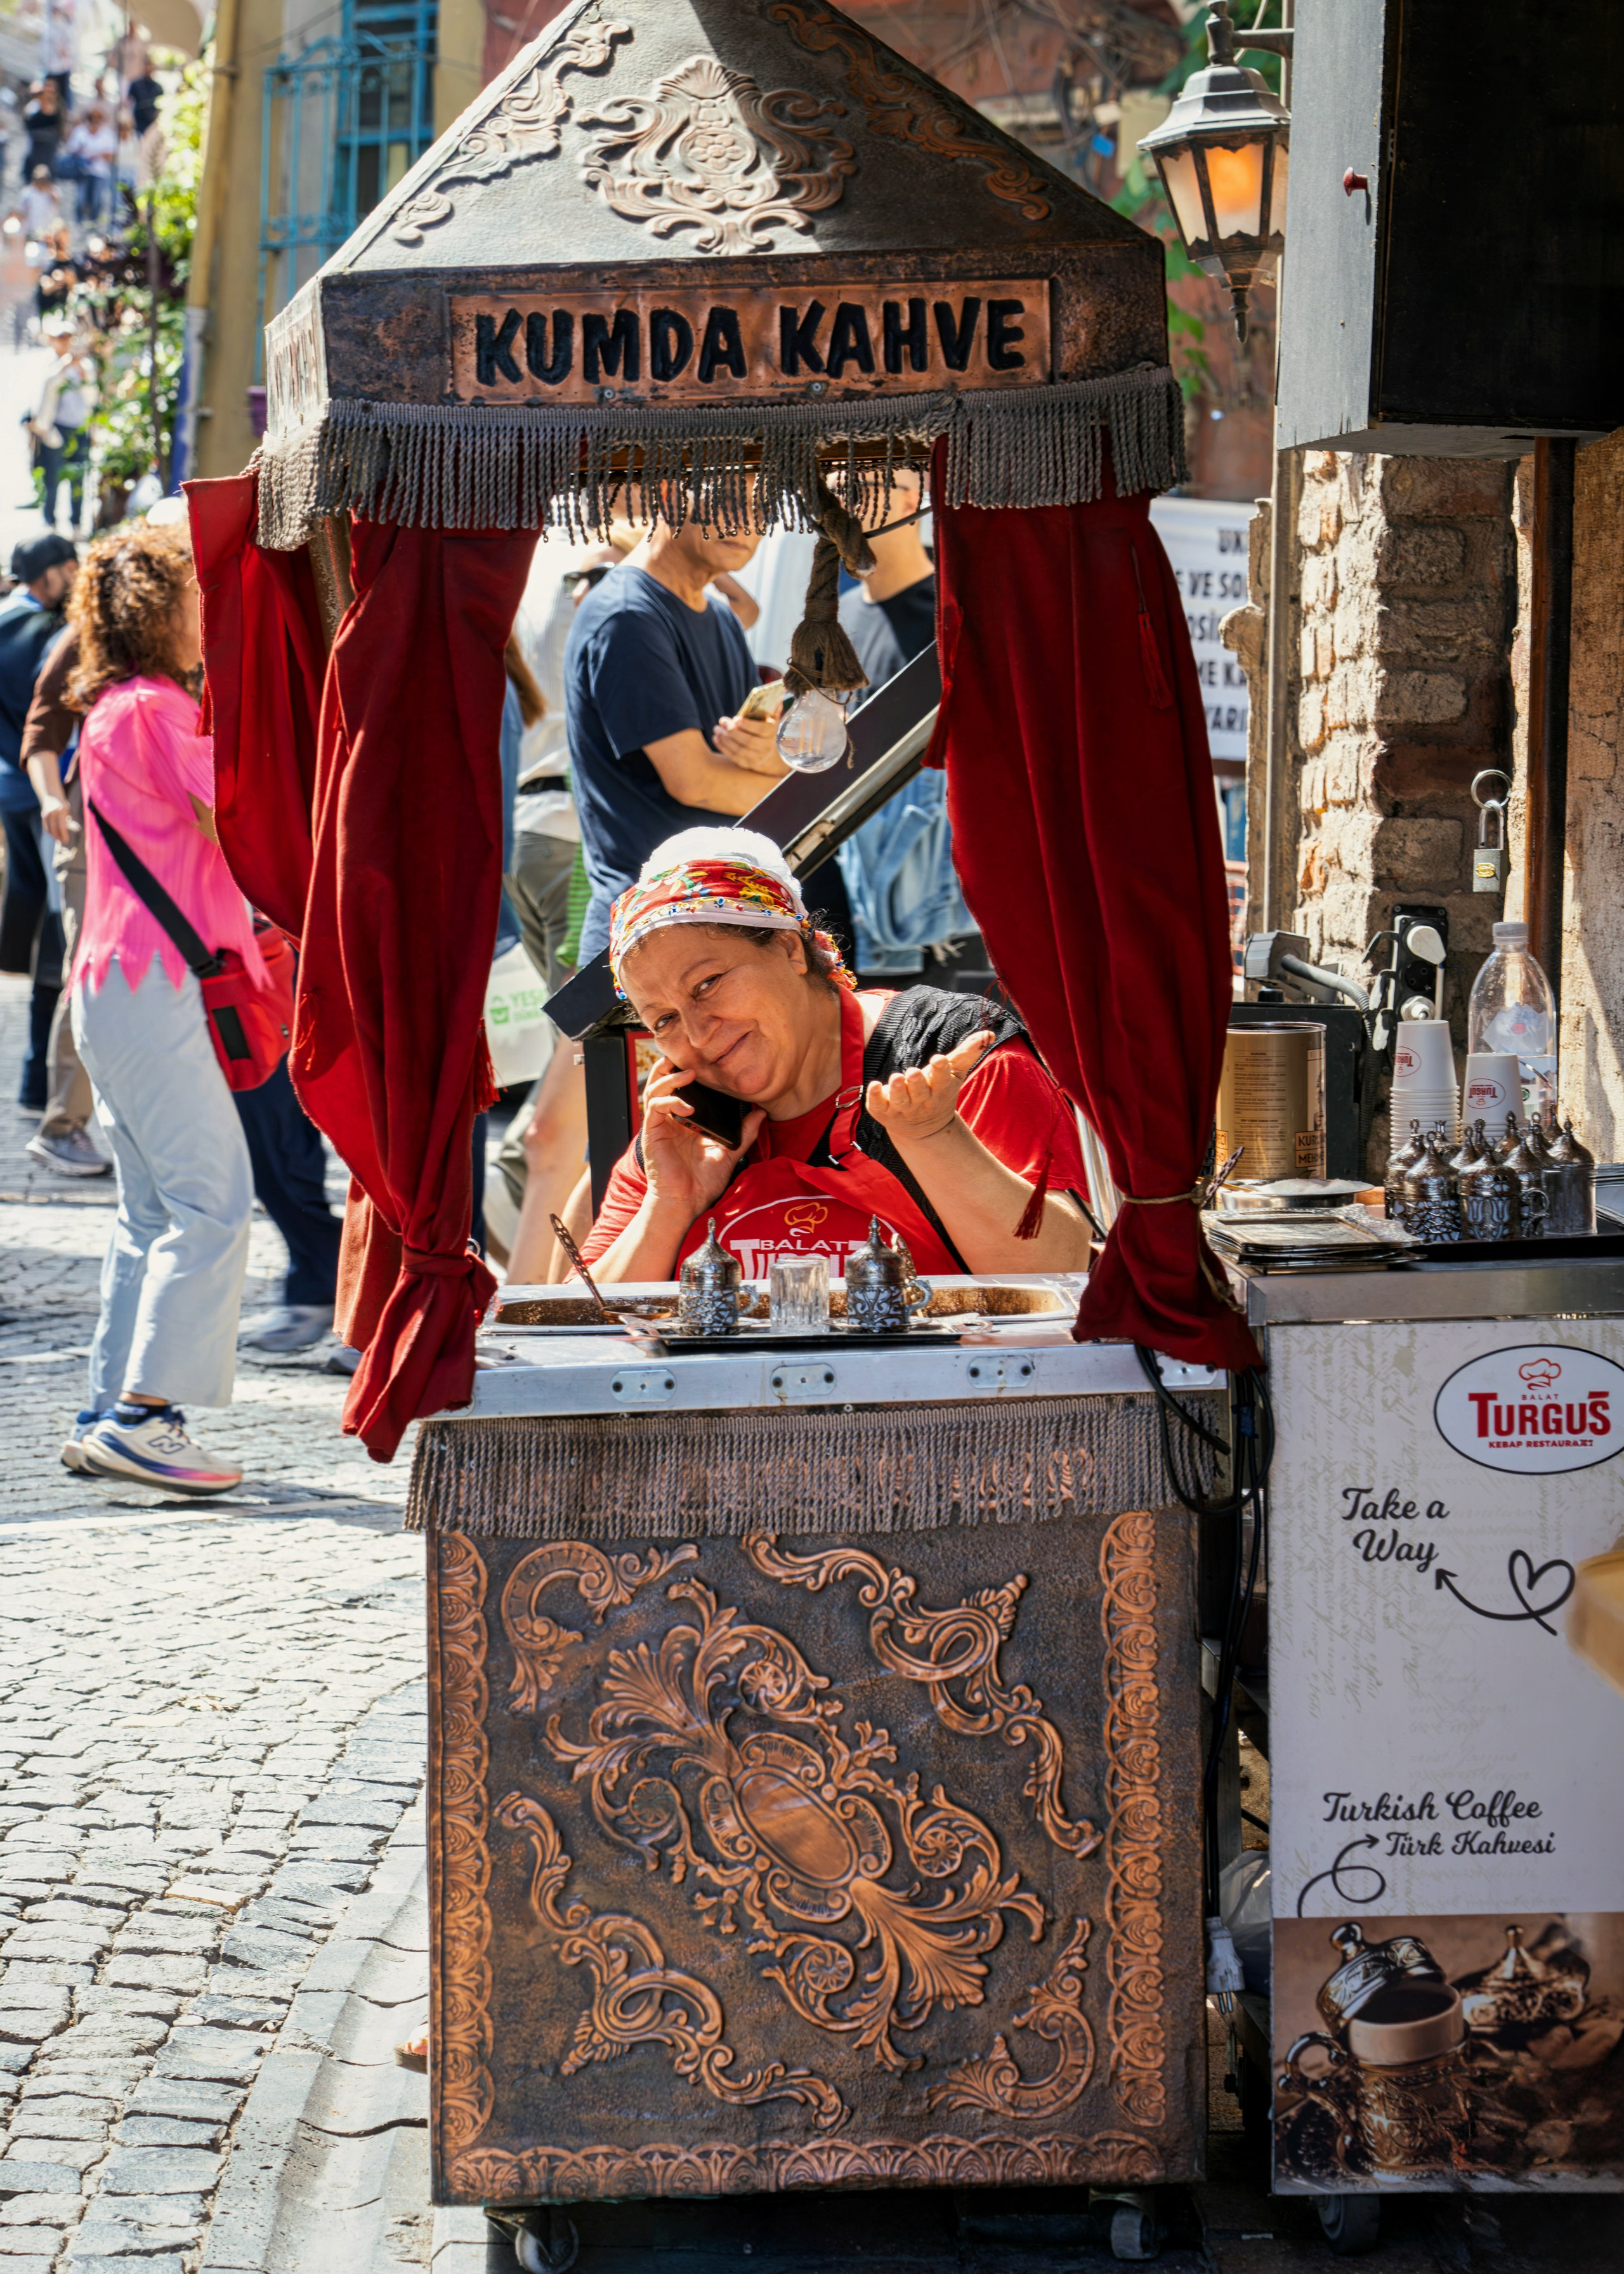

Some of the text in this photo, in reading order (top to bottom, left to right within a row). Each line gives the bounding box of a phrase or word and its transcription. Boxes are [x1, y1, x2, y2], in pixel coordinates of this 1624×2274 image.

[475, 296, 1025, 387] KUMDA KAHVE
[760, 1239, 849, 1252] BALAT
[1341, 1487, 1450, 1521] Take a
[1352, 1528, 1439, 1574] Way
[1323, 1789, 1543, 1828] Turkish Coffee
[1385, 1830, 1555, 1857] Türk Kahvesi
